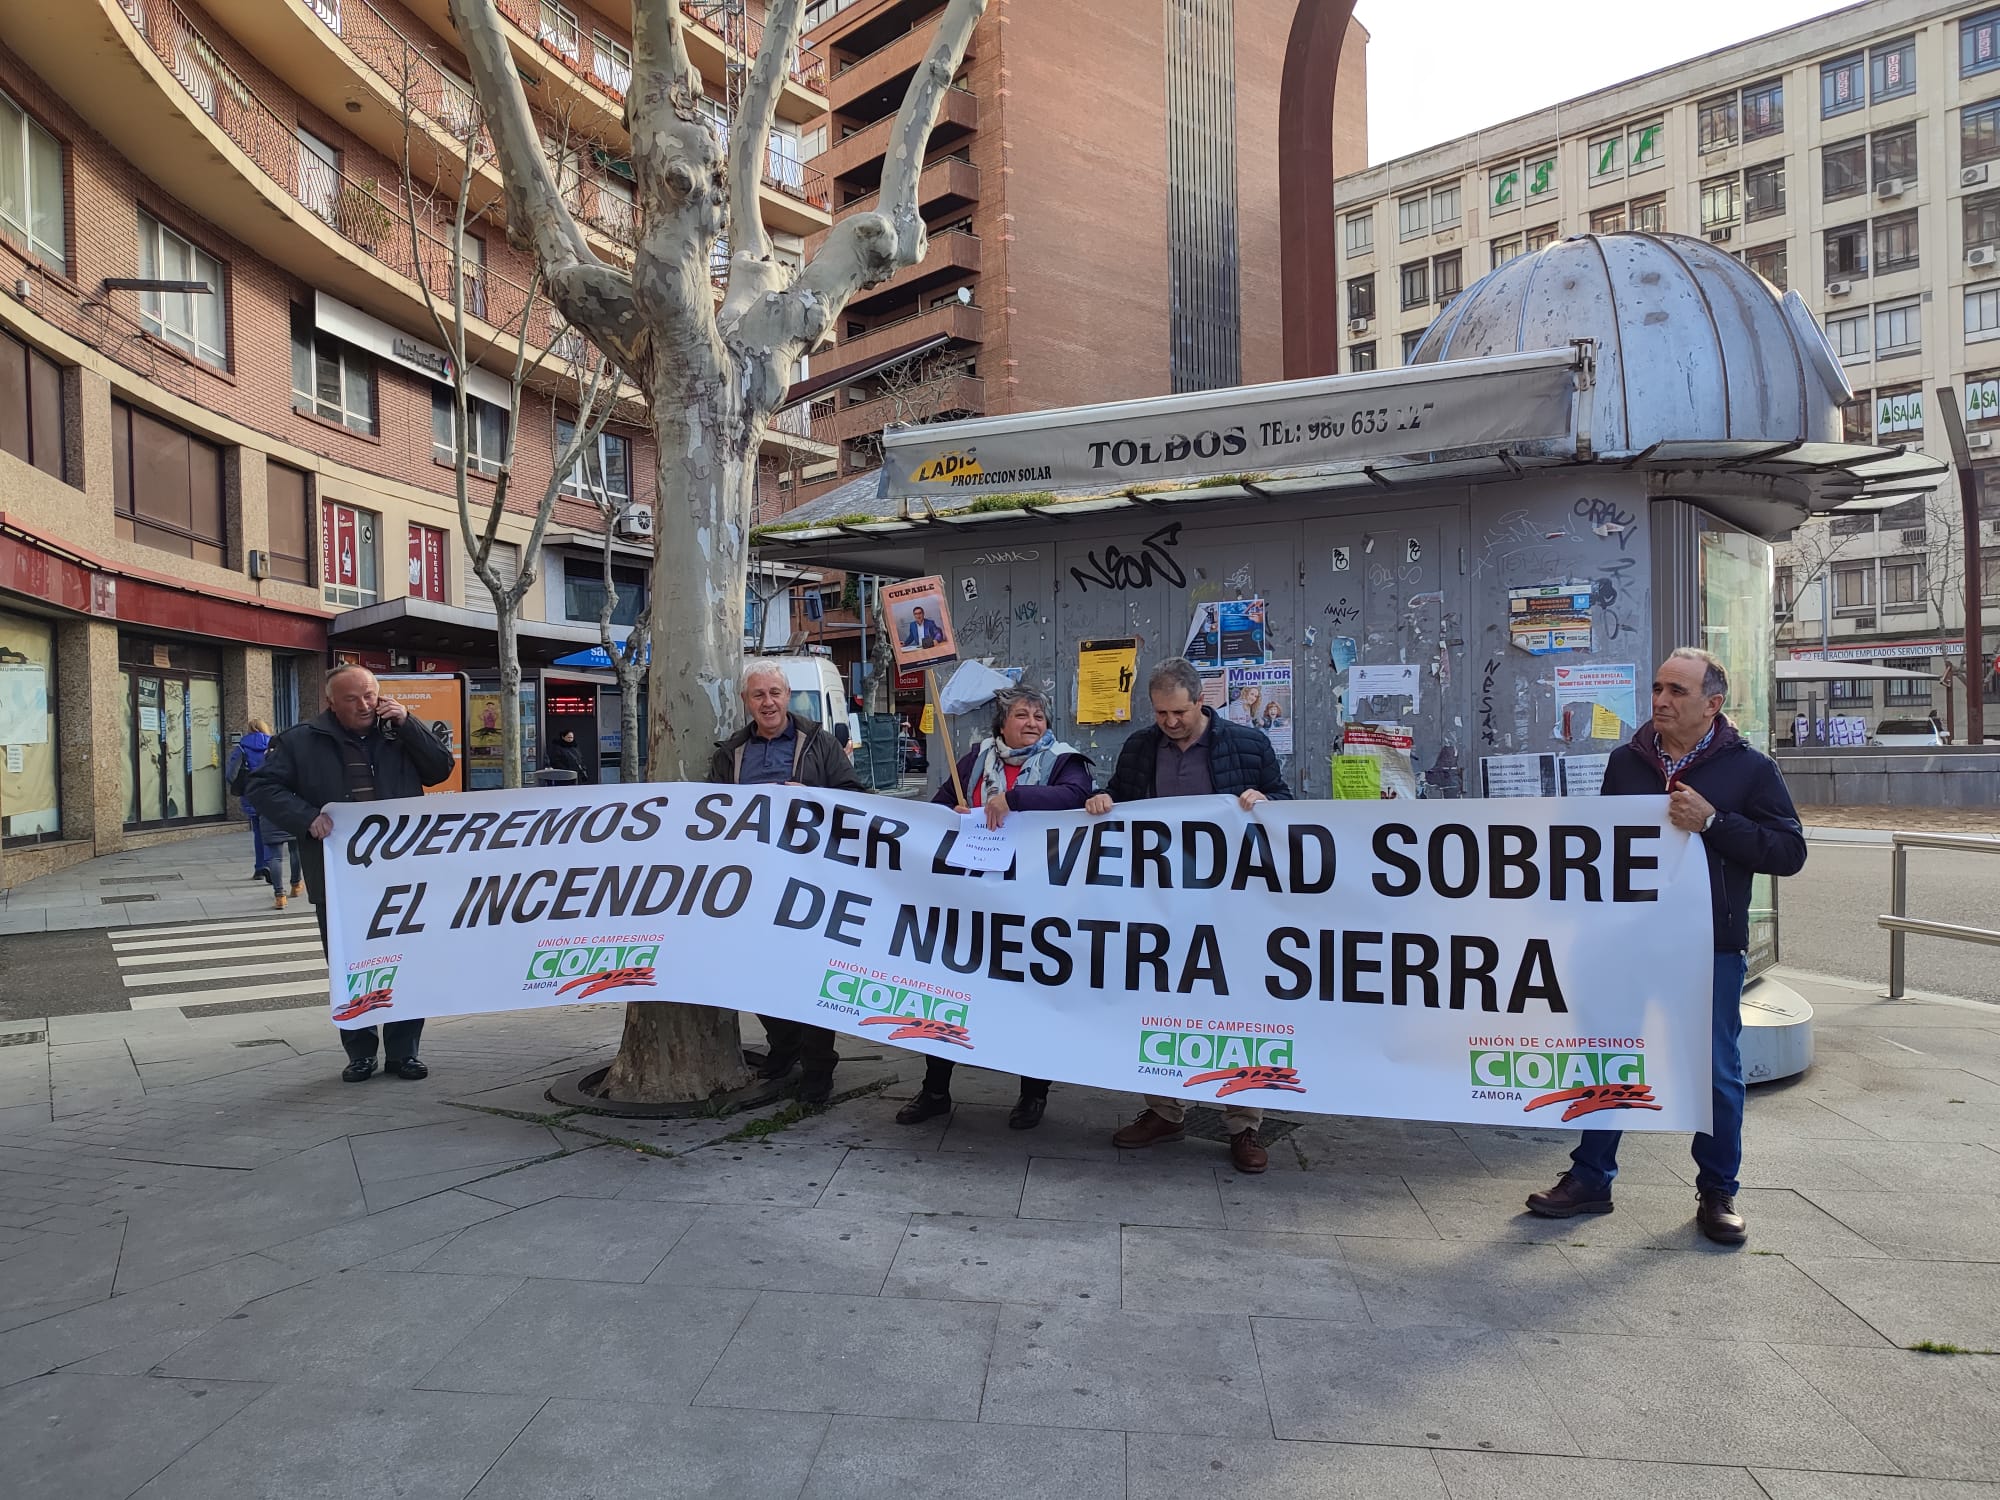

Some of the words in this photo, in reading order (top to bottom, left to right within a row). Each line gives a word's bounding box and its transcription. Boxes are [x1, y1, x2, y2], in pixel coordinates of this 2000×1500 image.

[1880, 402, 1923, 425] ASAJA
[1088, 426, 1248, 469] TOLDOS
[951, 471, 1016, 488] PROTECCION
[1018, 465, 1052, 481] SOLAR
[322, 505, 330, 580] VINACOTECA
[888, 583, 936, 599] CULPABLE
[1856, 647, 1896, 657] EMPLEADOS
[1897, 645, 1934, 656] SERVICIOS
[1229, 668, 1291, 683] MONITOR
[397, 692, 432, 700] ZAMORA
[347, 796, 668, 867] QUEREMOS
[685, 793, 909, 871] SABER
[932, 829, 1016, 881] L
[1046, 820, 1337, 894] VERDAD
[1372, 822, 1661, 902] SOBRE
[366, 882, 427, 940] EL
[449, 864, 752, 931] INCENDIO
[773, 877, 872, 948] DE
[888, 904, 1230, 996] NUESTRA
[1264, 926, 1568, 1013] SIERRA
[537, 936, 571, 948] UNIÓN
[573, 936, 588, 945] DE
[591, 933, 665, 944] CAMPESINOS
[349, 953, 404, 971] CAMPESINOS
[526, 945, 660, 980] COAG
[522, 980, 558, 991] ZAMORA
[829, 958, 868, 975] UNIÓN
[871, 970, 888, 981] DE
[891, 974, 972, 1002] CAMPESINOS
[820, 969, 969, 1027] COAG
[816, 1000, 860, 1017] ZAMORA
[1141, 1015, 1182, 1028] UNIÓN
[1186, 1018, 1203, 1030] DE
[1208, 1020, 1295, 1035] CAMPESINOS
[1139, 1030, 1293, 1070] COAG
[1469, 1034, 1514, 1047] UNIÓN
[1520, 1037, 1539, 1048] DE
[1544, 1037, 1645, 1049] CAMPESINOS
[1137, 1065, 1183, 1078] ZAMORA
[1470, 1050, 1645, 1090] COAG
[1471, 1090, 1522, 1101] ZAMORA
